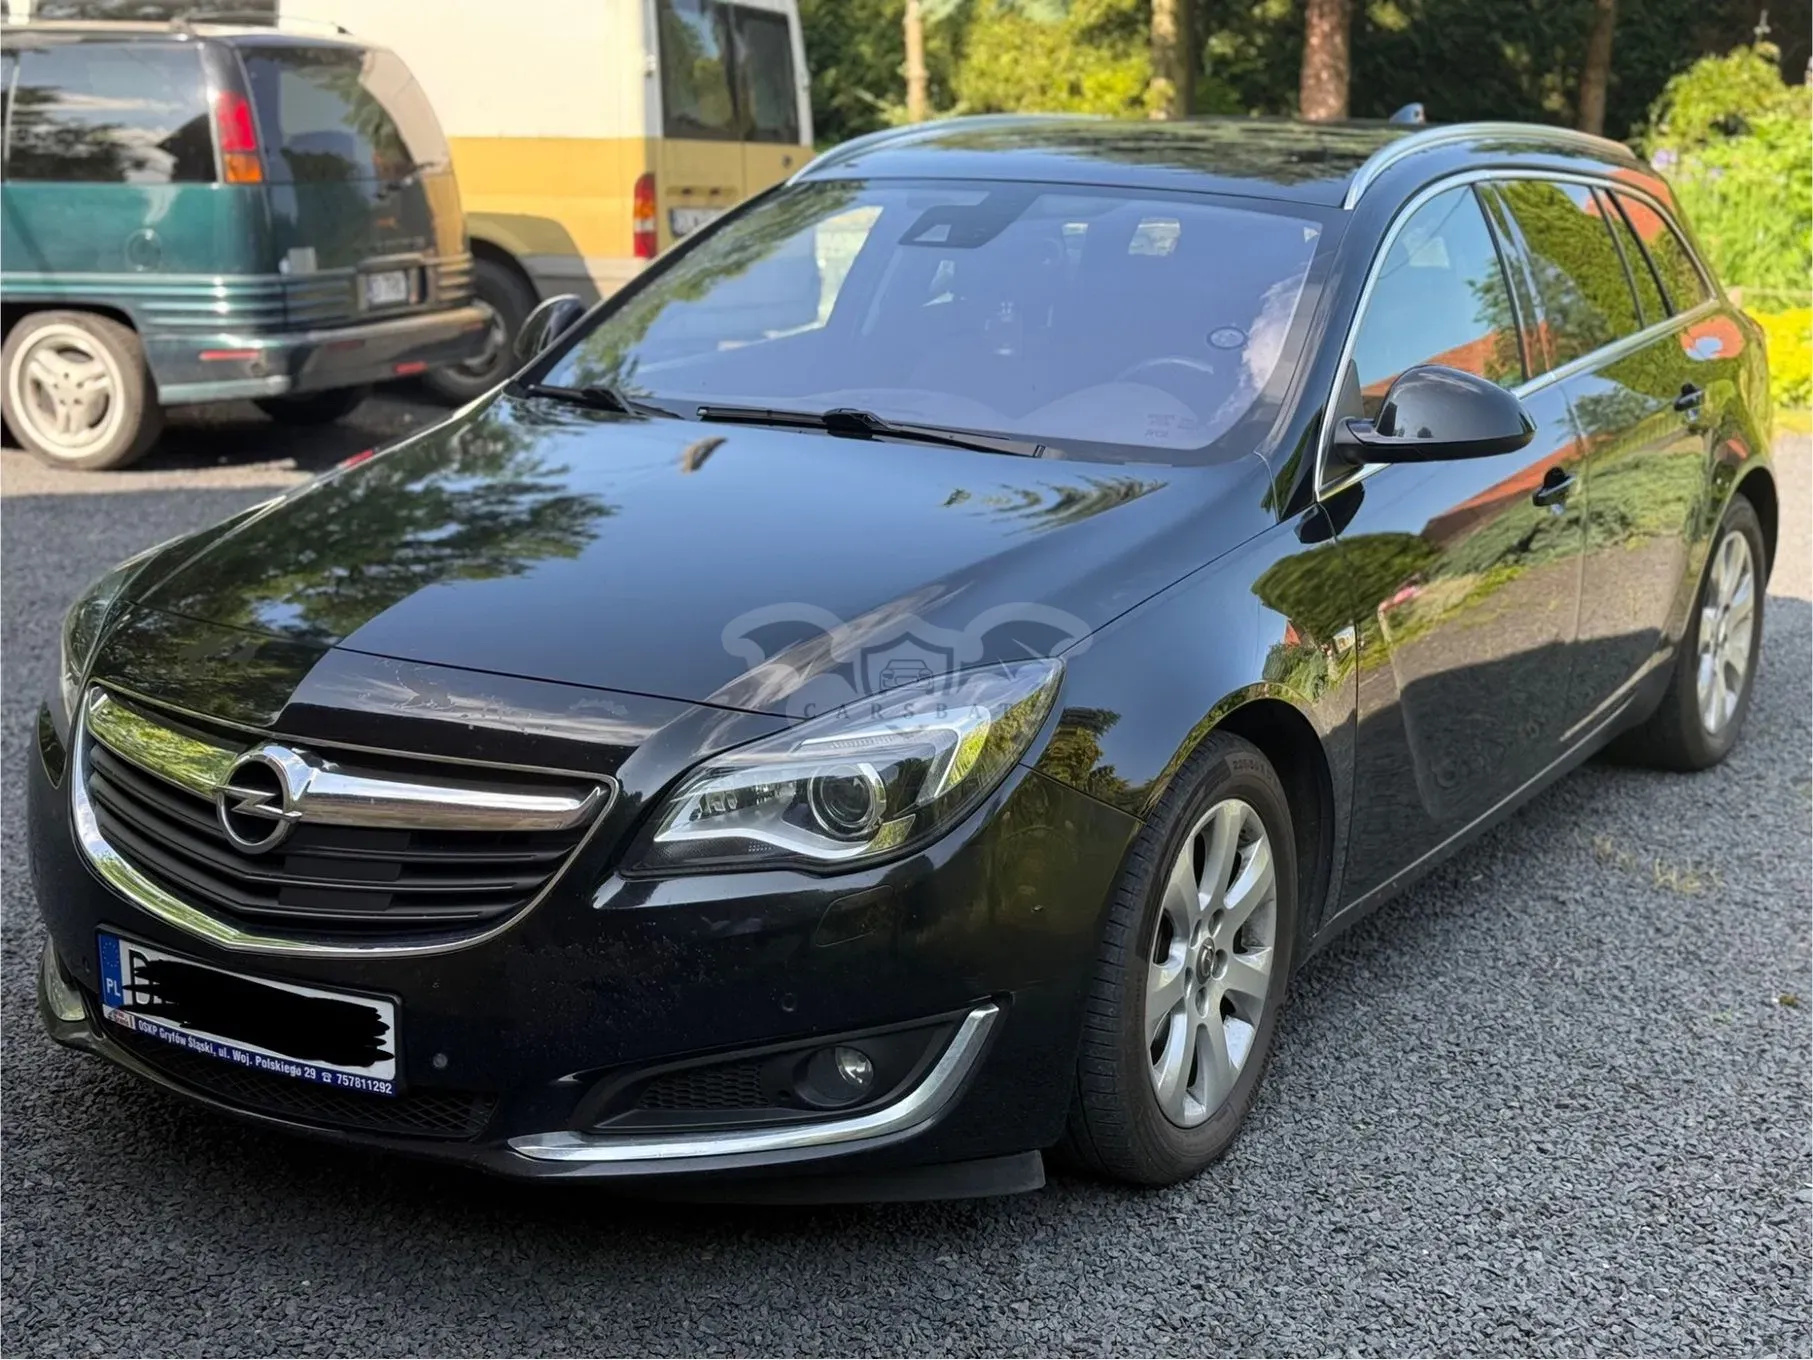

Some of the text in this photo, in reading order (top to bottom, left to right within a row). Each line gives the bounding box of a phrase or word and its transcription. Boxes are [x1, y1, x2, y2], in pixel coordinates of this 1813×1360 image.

[105, 977, 121, 997] PL
[138, 1020, 393, 1094] OSKP Gryfów Śląski, ul. Woj. Polskiego 29 757811292
